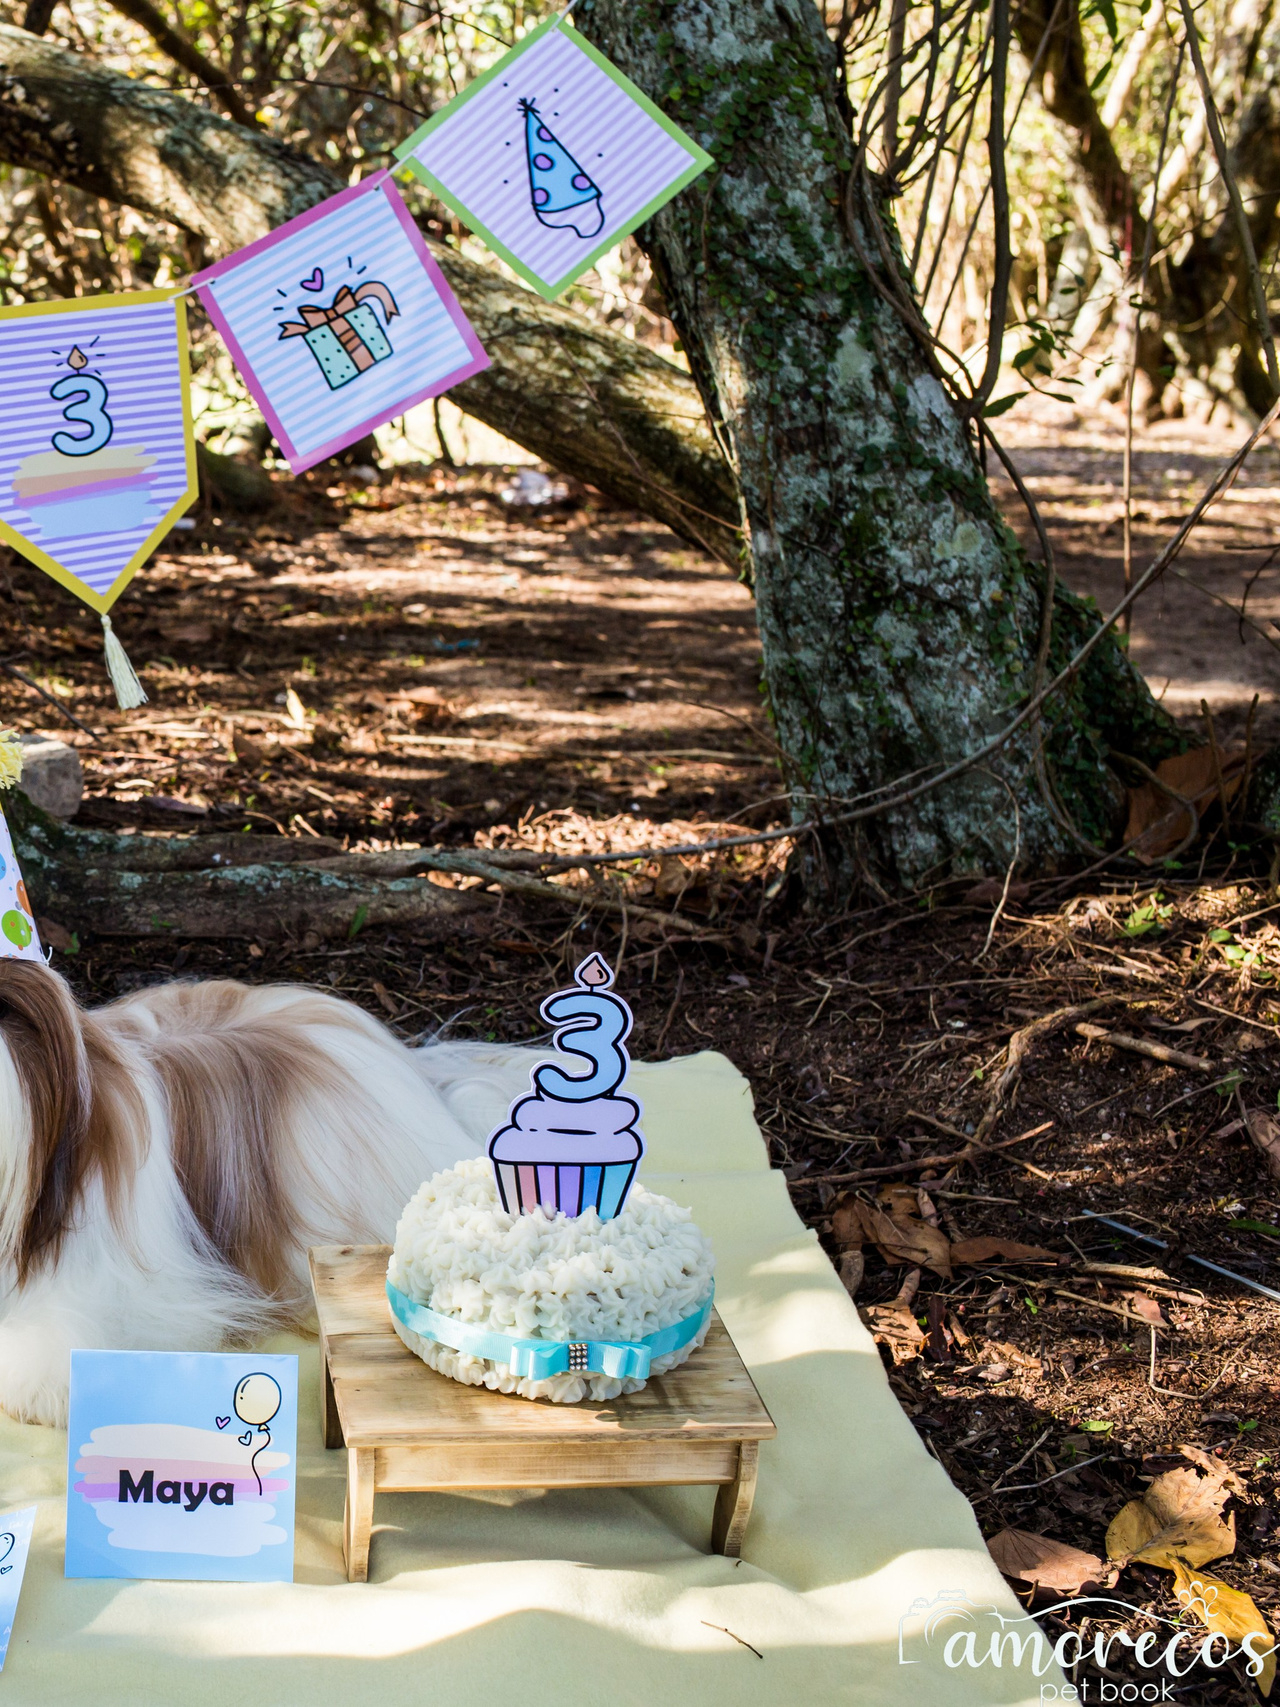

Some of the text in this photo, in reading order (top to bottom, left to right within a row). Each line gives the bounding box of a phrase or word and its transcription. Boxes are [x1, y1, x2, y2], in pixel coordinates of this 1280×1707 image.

[49, 373, 114, 457] 3
[533, 990, 630, 1102] 3
[118, 1469, 235, 1512] Maya
